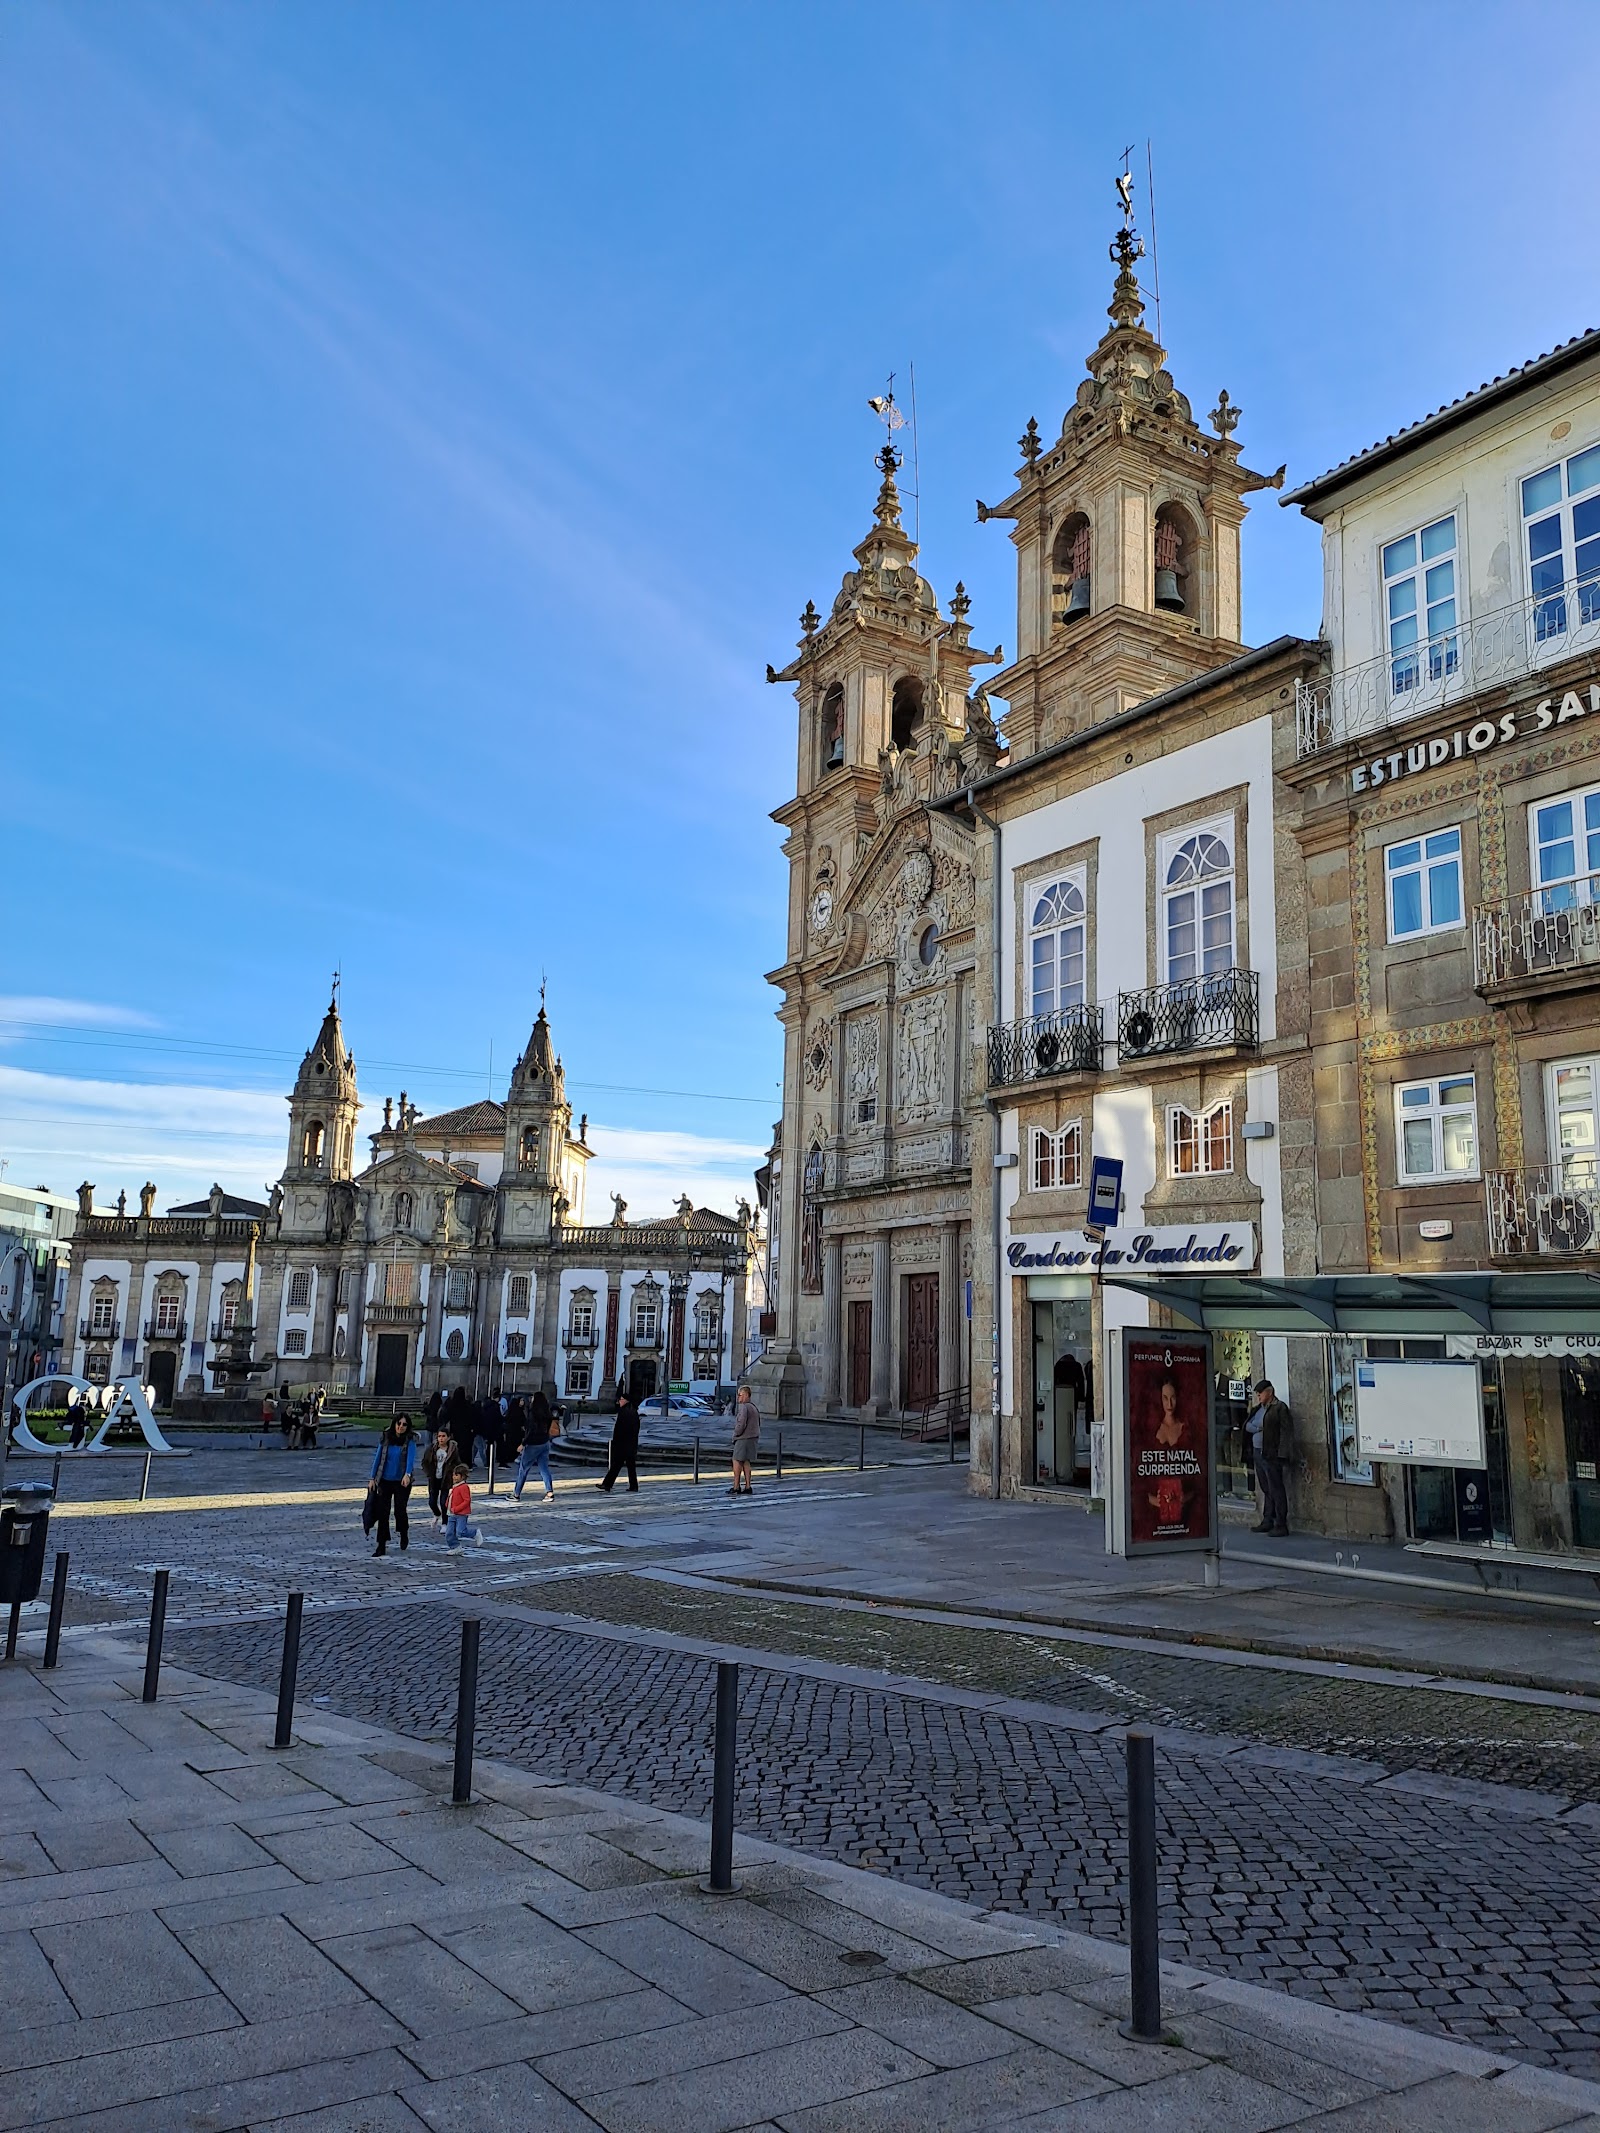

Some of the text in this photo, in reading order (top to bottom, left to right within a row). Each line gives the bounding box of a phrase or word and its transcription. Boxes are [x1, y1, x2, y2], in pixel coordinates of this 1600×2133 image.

[1352, 713, 1515, 793] ESTÚDIOS
[1007, 1233, 1243, 1267] Cardoso da Saudade
[1476, 1336, 1523, 1349] BAZAR
[1134, 1353, 1163, 1362] PERFUMES
[1173, 1355, 1201, 1363] COMPANHIA
[1141, 1450, 1198, 1462] ESTE NATAL
[1137, 1463, 1201, 1476] SURPREENDA
